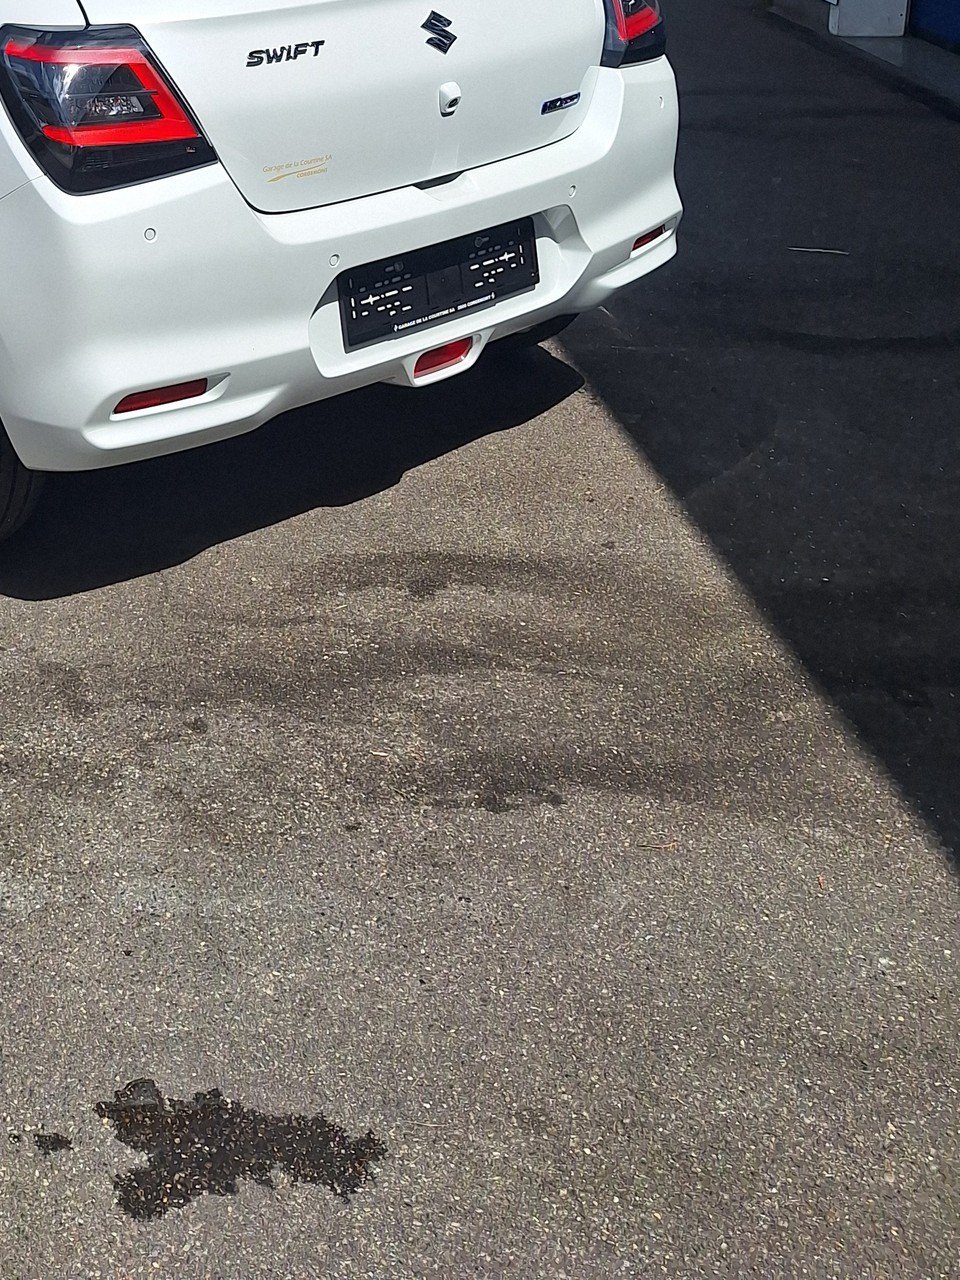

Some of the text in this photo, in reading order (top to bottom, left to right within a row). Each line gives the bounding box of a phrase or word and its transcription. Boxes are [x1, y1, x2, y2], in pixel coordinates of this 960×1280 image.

[246, 40, 325, 67] SWIFT
[262, 164, 284, 173] Garage
[398, 319, 416, 330] GARAGE
